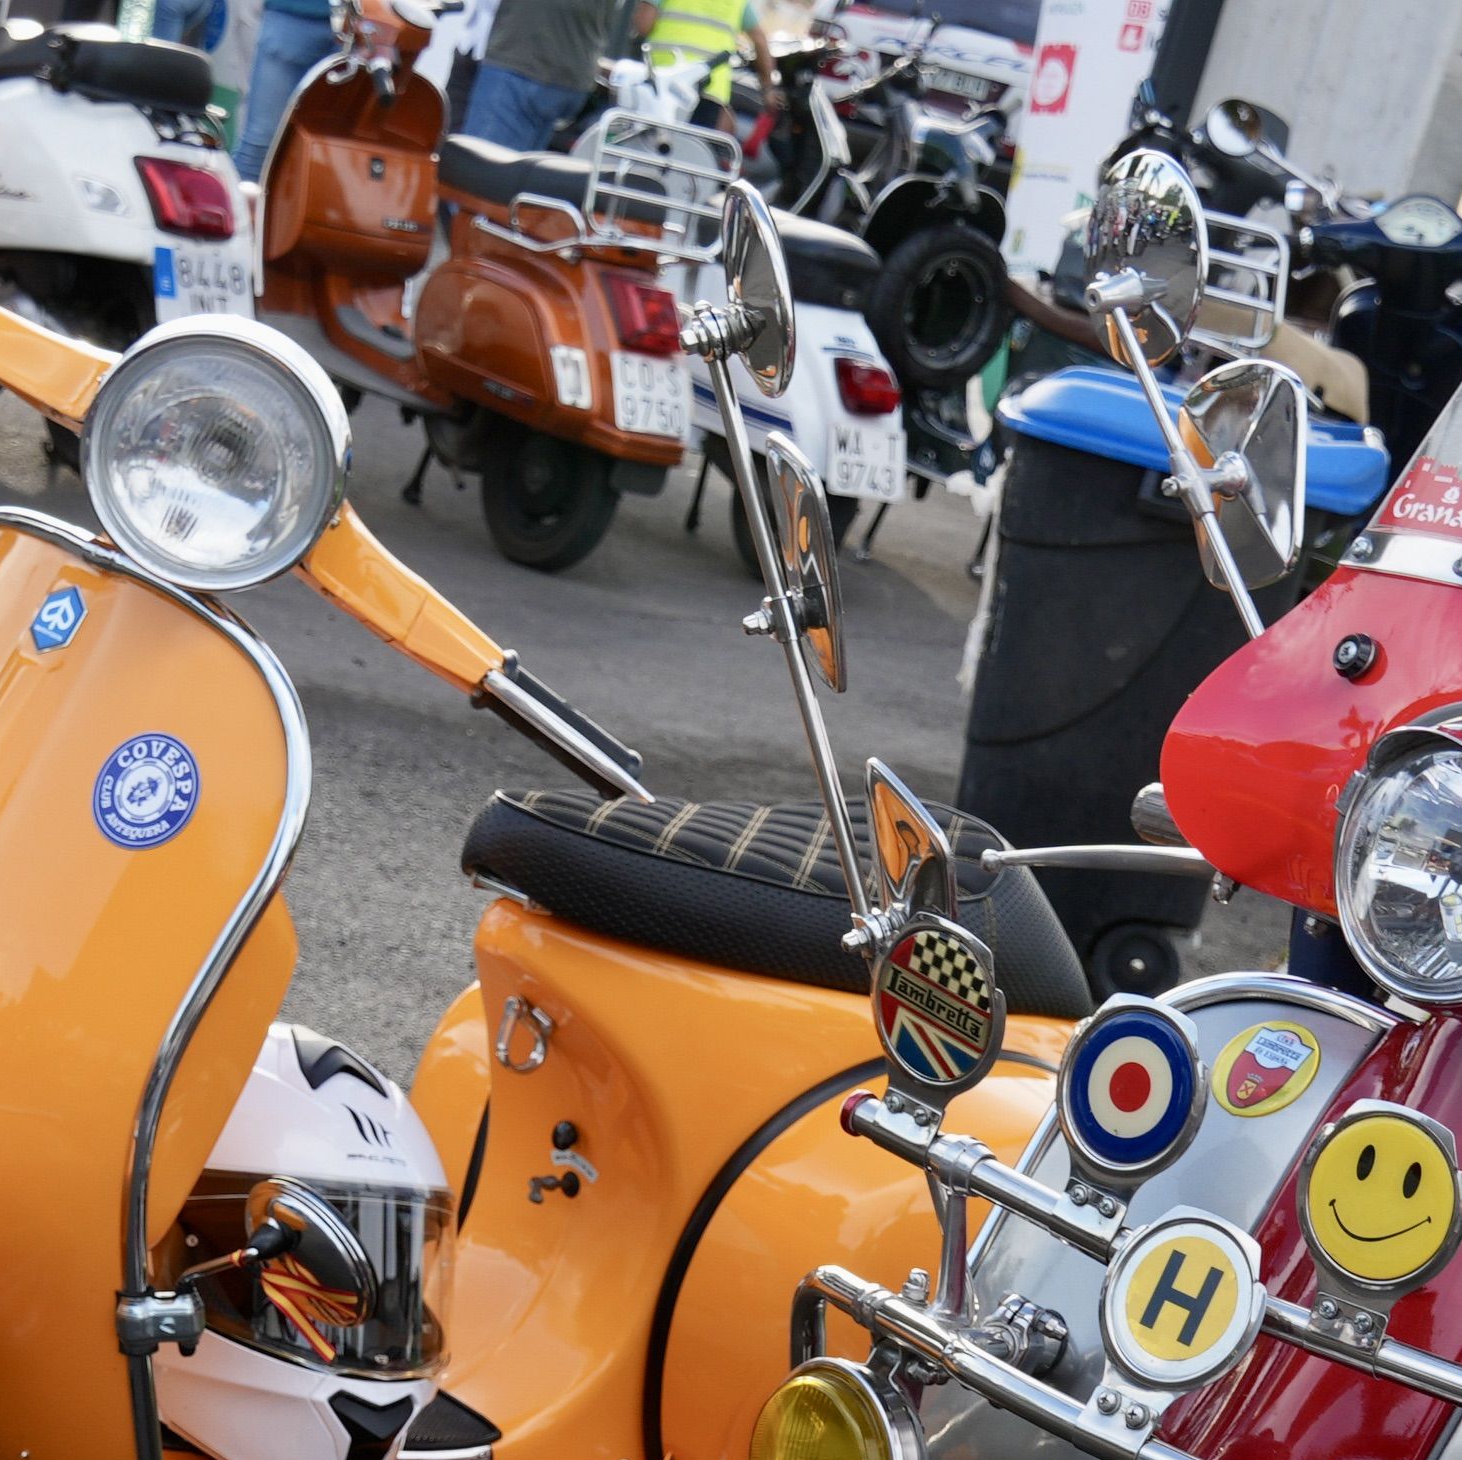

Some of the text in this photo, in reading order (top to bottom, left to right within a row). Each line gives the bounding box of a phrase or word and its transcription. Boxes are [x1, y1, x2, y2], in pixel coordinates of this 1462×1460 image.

[179, 259, 246, 296] 8448
[623, 394, 685, 434] 9750
[837, 461, 898, 497] 9743
[100, 775, 115, 809] CLUB
[117, 740, 190, 812] COVESPA
[887, 965, 984, 1043] Lambretta
[1140, 1249, 1225, 1347] H
